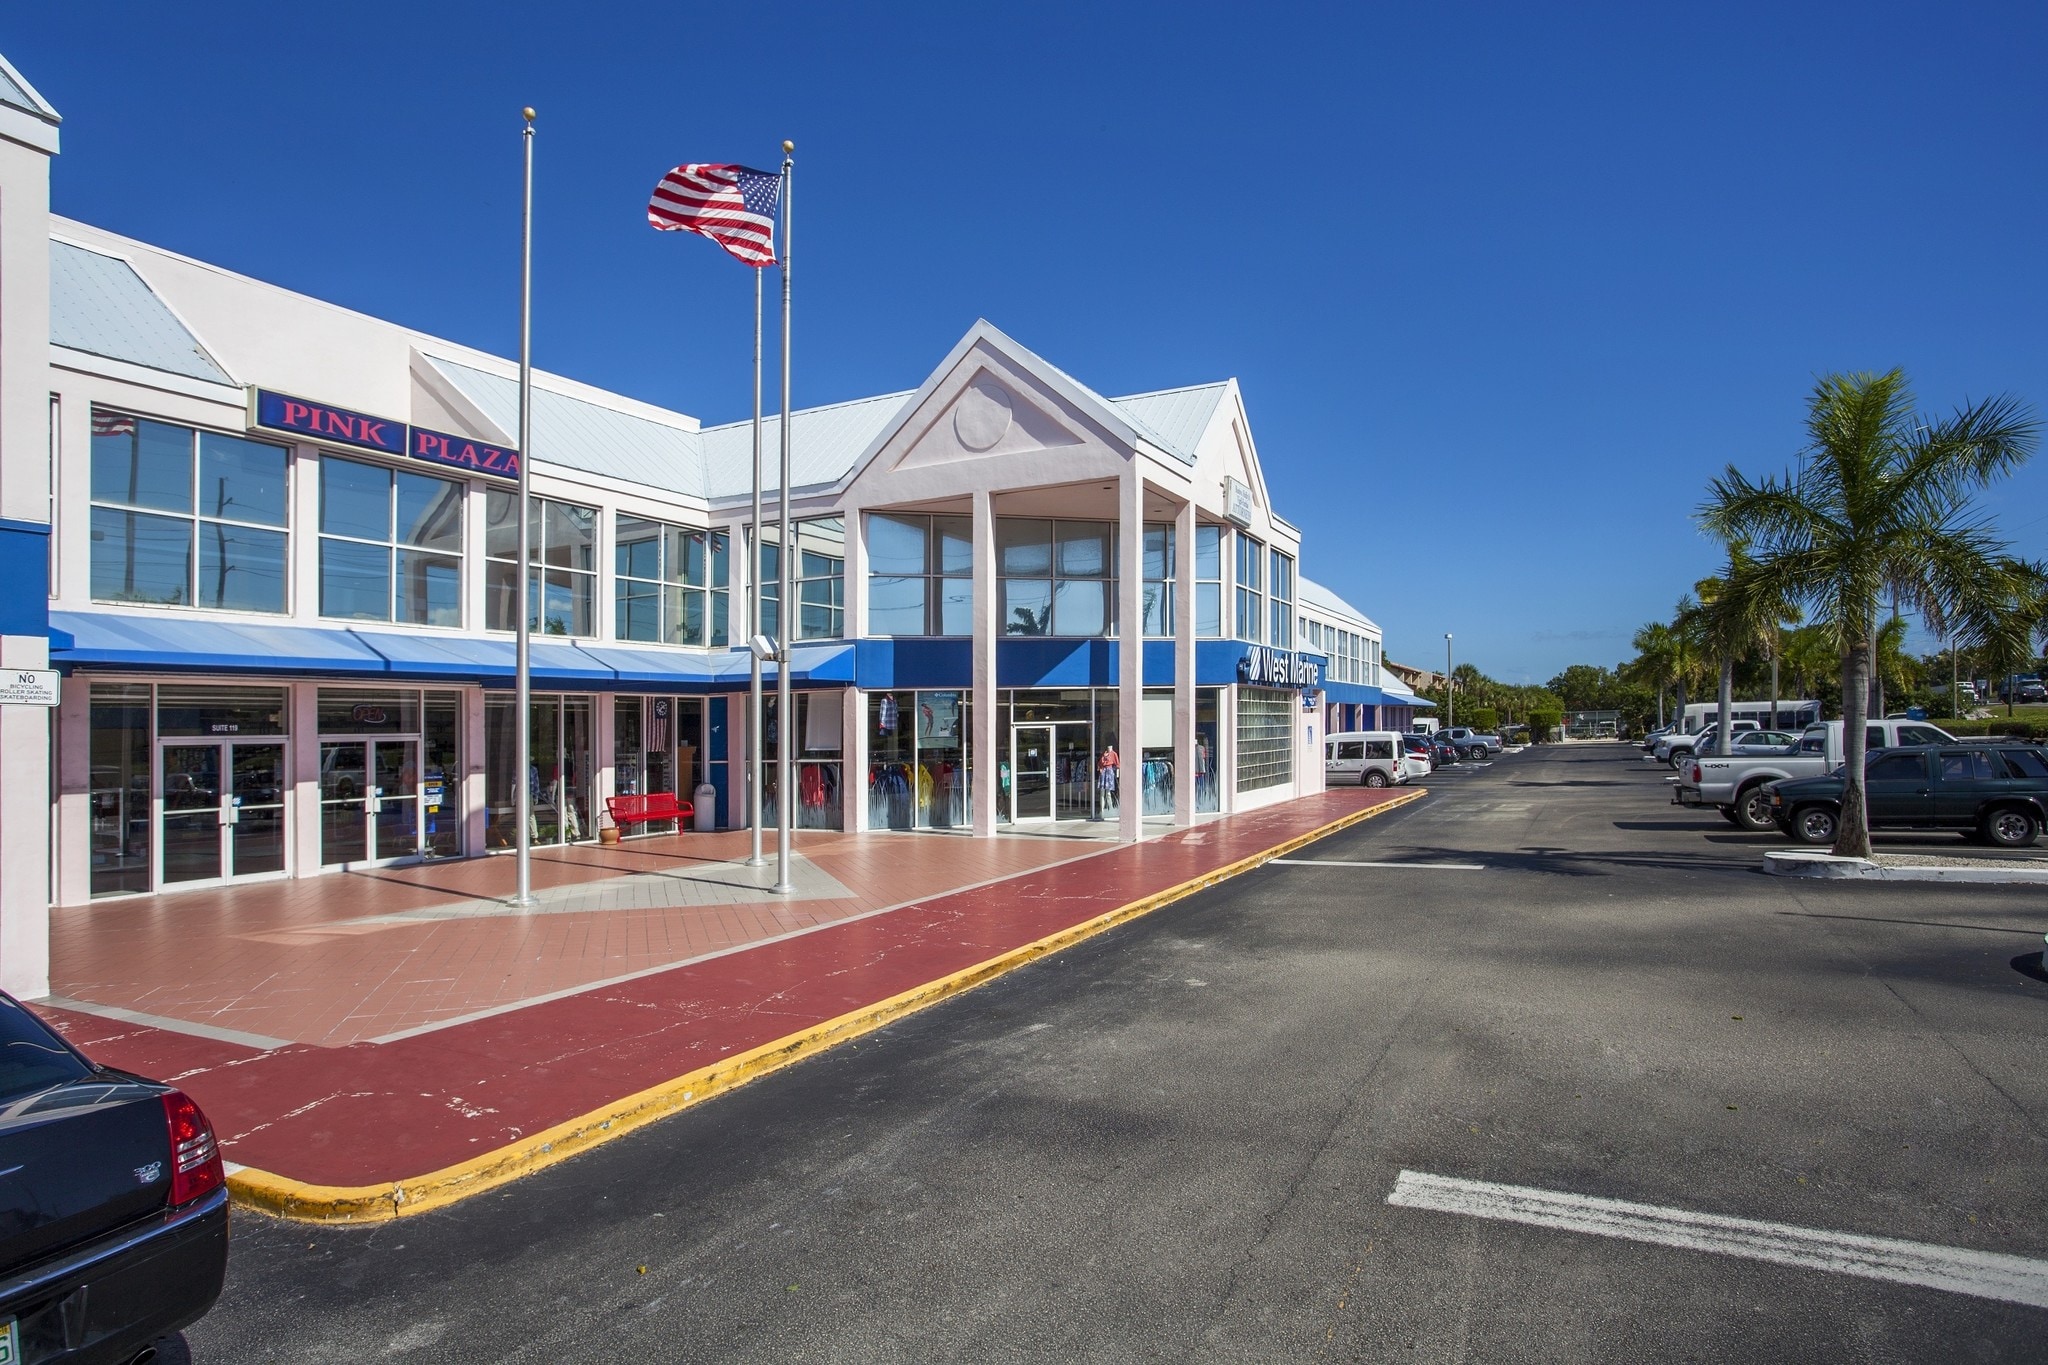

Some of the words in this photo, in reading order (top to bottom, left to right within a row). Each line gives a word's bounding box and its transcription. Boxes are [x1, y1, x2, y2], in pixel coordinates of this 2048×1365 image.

[283, 400, 386, 446] PINK
[417, 432, 520, 474] PLAZA
[19, 674, 36, 684] NO
[1262, 647, 1289, 684] West
[1290, 652, 1319, 686] Marine
